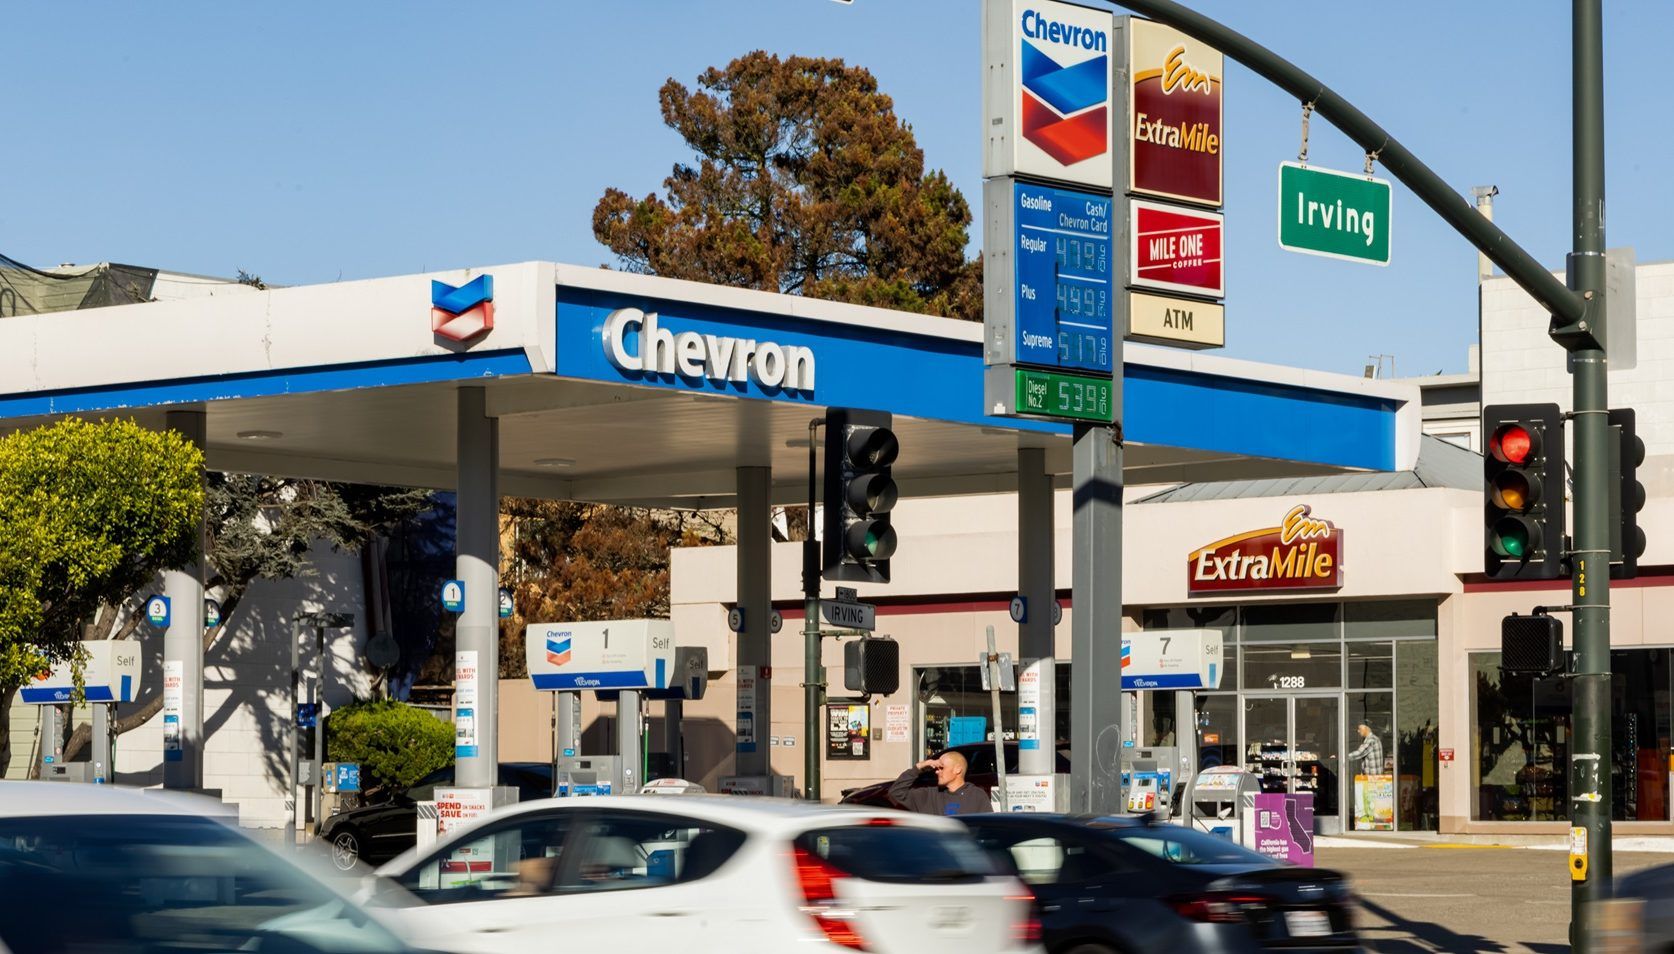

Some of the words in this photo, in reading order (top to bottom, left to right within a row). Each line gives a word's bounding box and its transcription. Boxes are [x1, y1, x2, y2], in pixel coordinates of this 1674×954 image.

[1021, 9, 1106, 52] Chevron
[1135, 112, 1219, 155] ExtraMile
[1021, 193, 1052, 212] Gasoline
[1085, 202, 1107, 218] Cash/
[1059, 213, 1089, 230] Chevron
[1090, 218, 1108, 233] Card
[1298, 192, 1374, 247] Irving
[1021, 235, 1047, 253] Regular
[1056, 237, 1095, 271] 479
[1149, 236, 1176, 261] MILE
[1180, 233, 1203, 258] ONE
[1172, 258, 1203, 269] COFFEE
[1021, 284, 1036, 301] Plus
[1163, 308, 1193, 331] ATM
[603, 307, 816, 391] Chevron
[1022, 330, 1053, 350] Supreme
[1058, 331, 1097, 363] 517
[1028, 380, 1047, 395] Diesel
[1059, 381, 1097, 413] 539
[1028, 395, 1042, 408] No.2
[1194, 542, 1333, 581] ExtraMile
[451, 588, 456, 599] 1
[154, 603, 161, 614] 3
[831, 605, 864, 624] IRVING
[1014, 603, 1020, 615] 7
[732, 613, 738, 625] 5
[771, 615, 778, 627] 6
[546, 630, 572, 638] Chevron
[602, 628, 609, 649] 1
[653, 637, 670, 650] Self
[1160, 637, 1171, 655] 7
[1206, 644, 1219, 655] Self
[117, 655, 135, 667] Self
[689, 659, 704, 671] Self
[1279, 676, 1305, 688] 1288
[437, 802, 462, 810] SPEND
